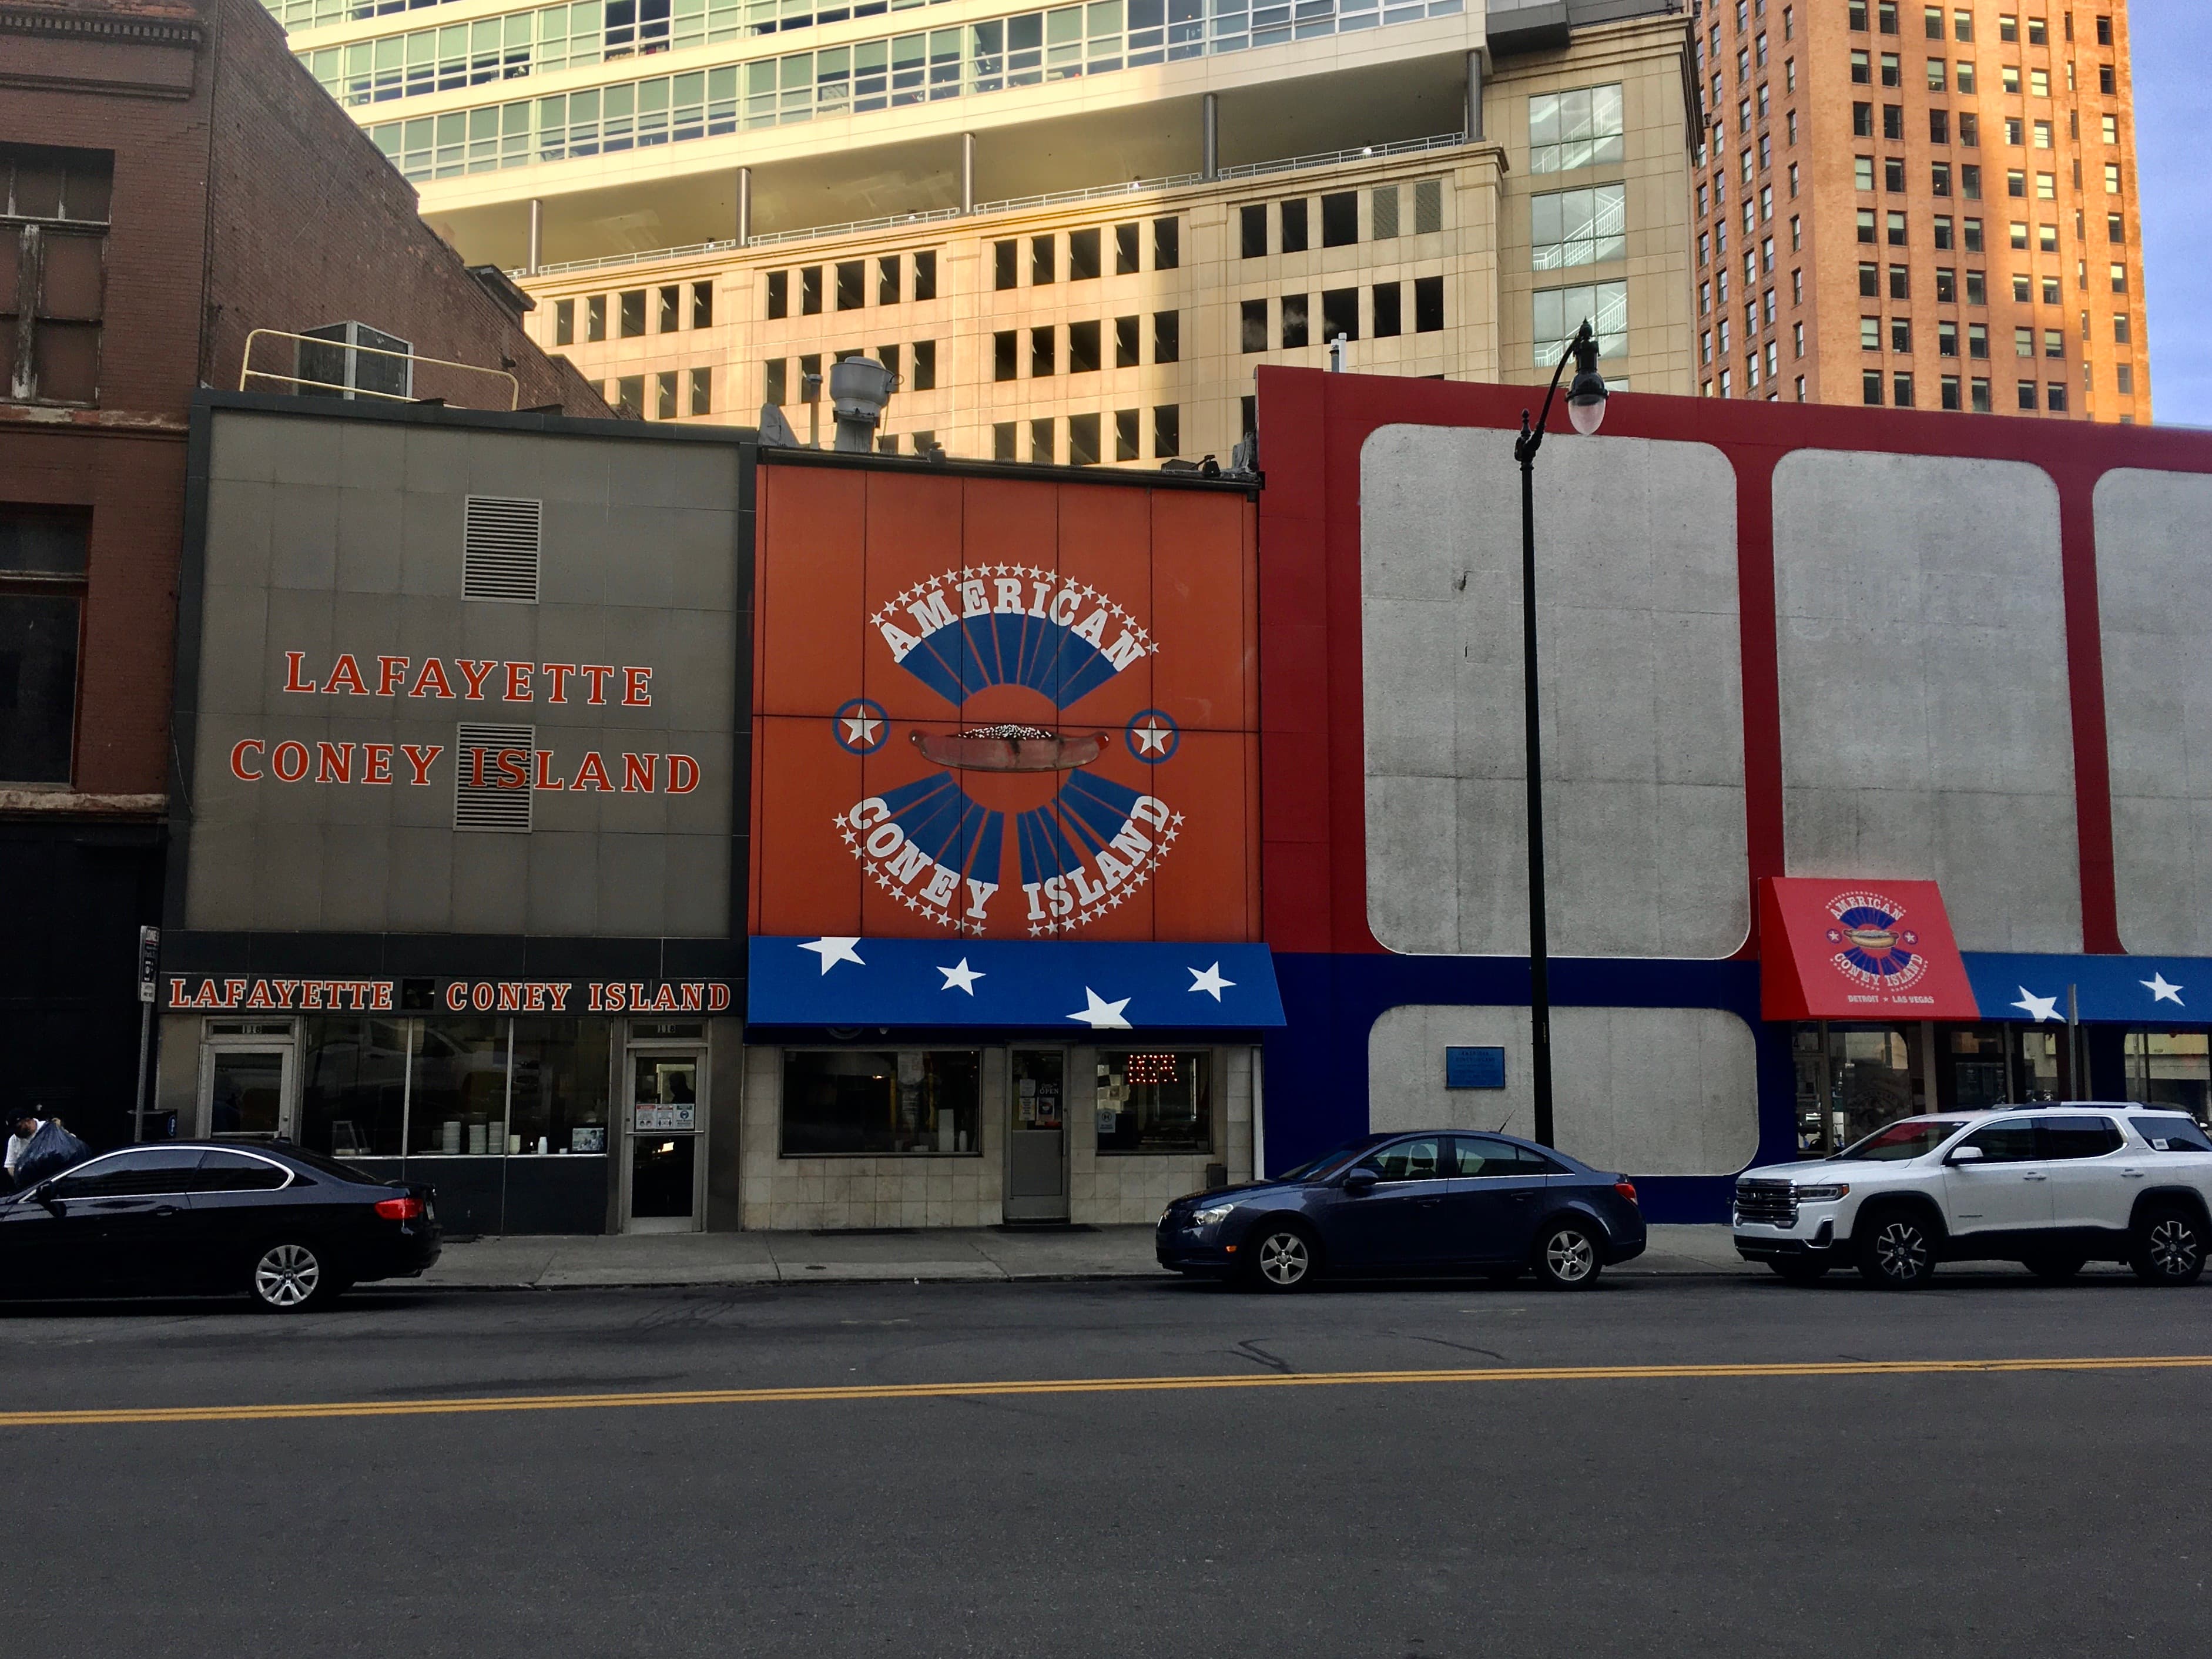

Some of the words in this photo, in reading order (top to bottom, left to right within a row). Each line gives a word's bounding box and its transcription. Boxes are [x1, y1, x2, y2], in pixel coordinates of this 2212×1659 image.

[880, 578, 1147, 672] AMERICAN
[283, 651, 653, 707] LAFAYETTE
[230, 739, 444, 786] CONEY
[470, 747, 701, 794] ISLAND
[849, 797, 999, 920] CONEY
[1021, 795, 1170, 921] ISLAND
[1830, 896, 1904, 921] AMERICAN
[1834, 953, 1881, 986] CONEY
[1884, 953, 1923, 987] ISLAND
[169, 978, 393, 1010] LAFAYETTE
[445, 982, 572, 1011] CONEY
[588, 983, 732, 1011] ISLAND
[1847, 994, 1879, 1003] DETROIT
[1892, 996, 1908, 1004] LAS
[1908, 996, 1935, 1004] VEGAS
[244, 1025, 262, 1034] 118
[658, 1025, 676, 1034] 118
